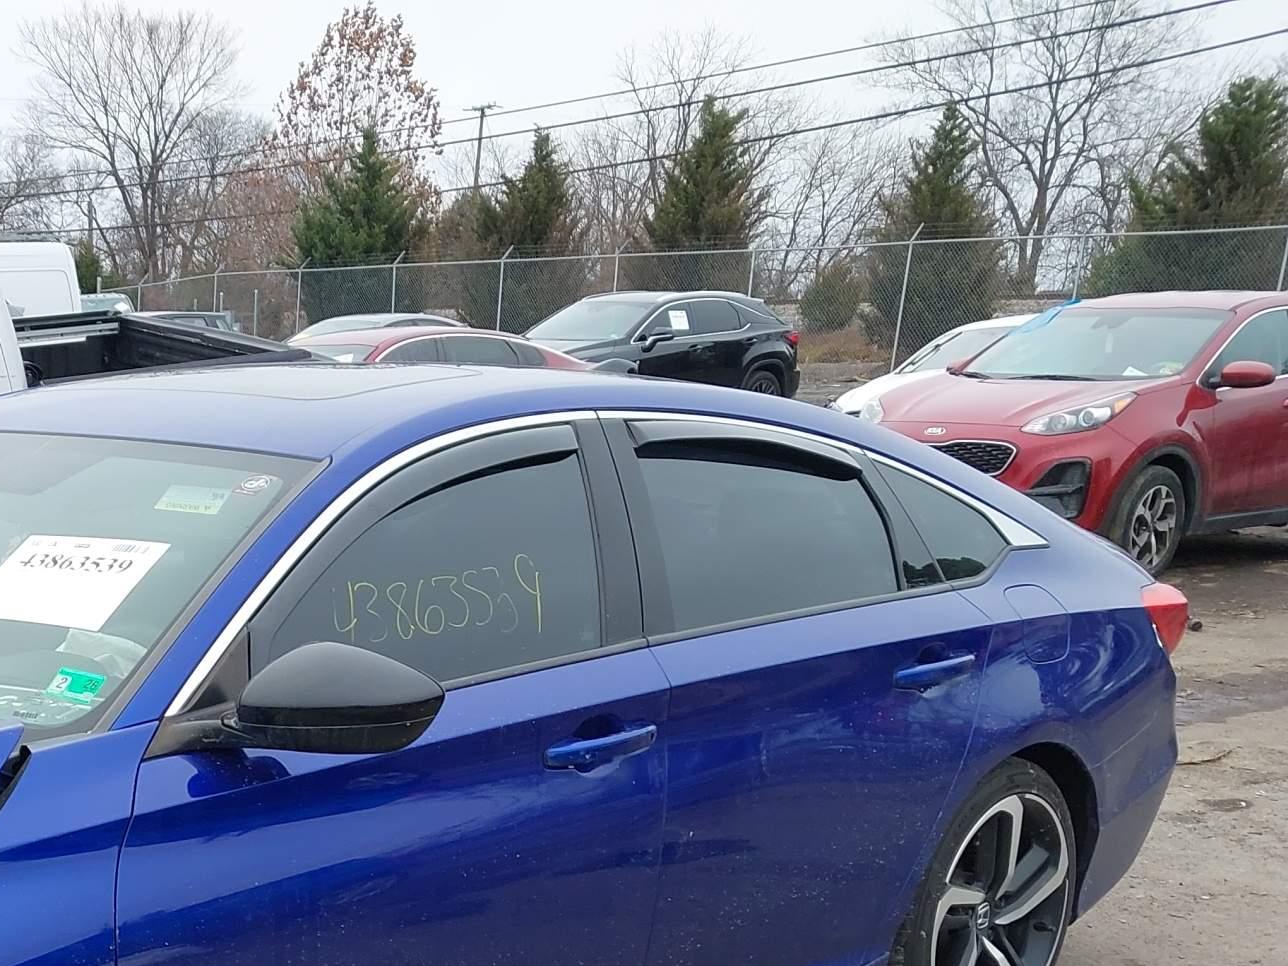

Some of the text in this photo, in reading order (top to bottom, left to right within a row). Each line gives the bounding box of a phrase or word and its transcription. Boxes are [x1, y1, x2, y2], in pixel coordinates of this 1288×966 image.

[20, 552, 133, 573] 43863539
[332, 554, 542, 643] 43863539
[57, 677, 68, 689] 2
